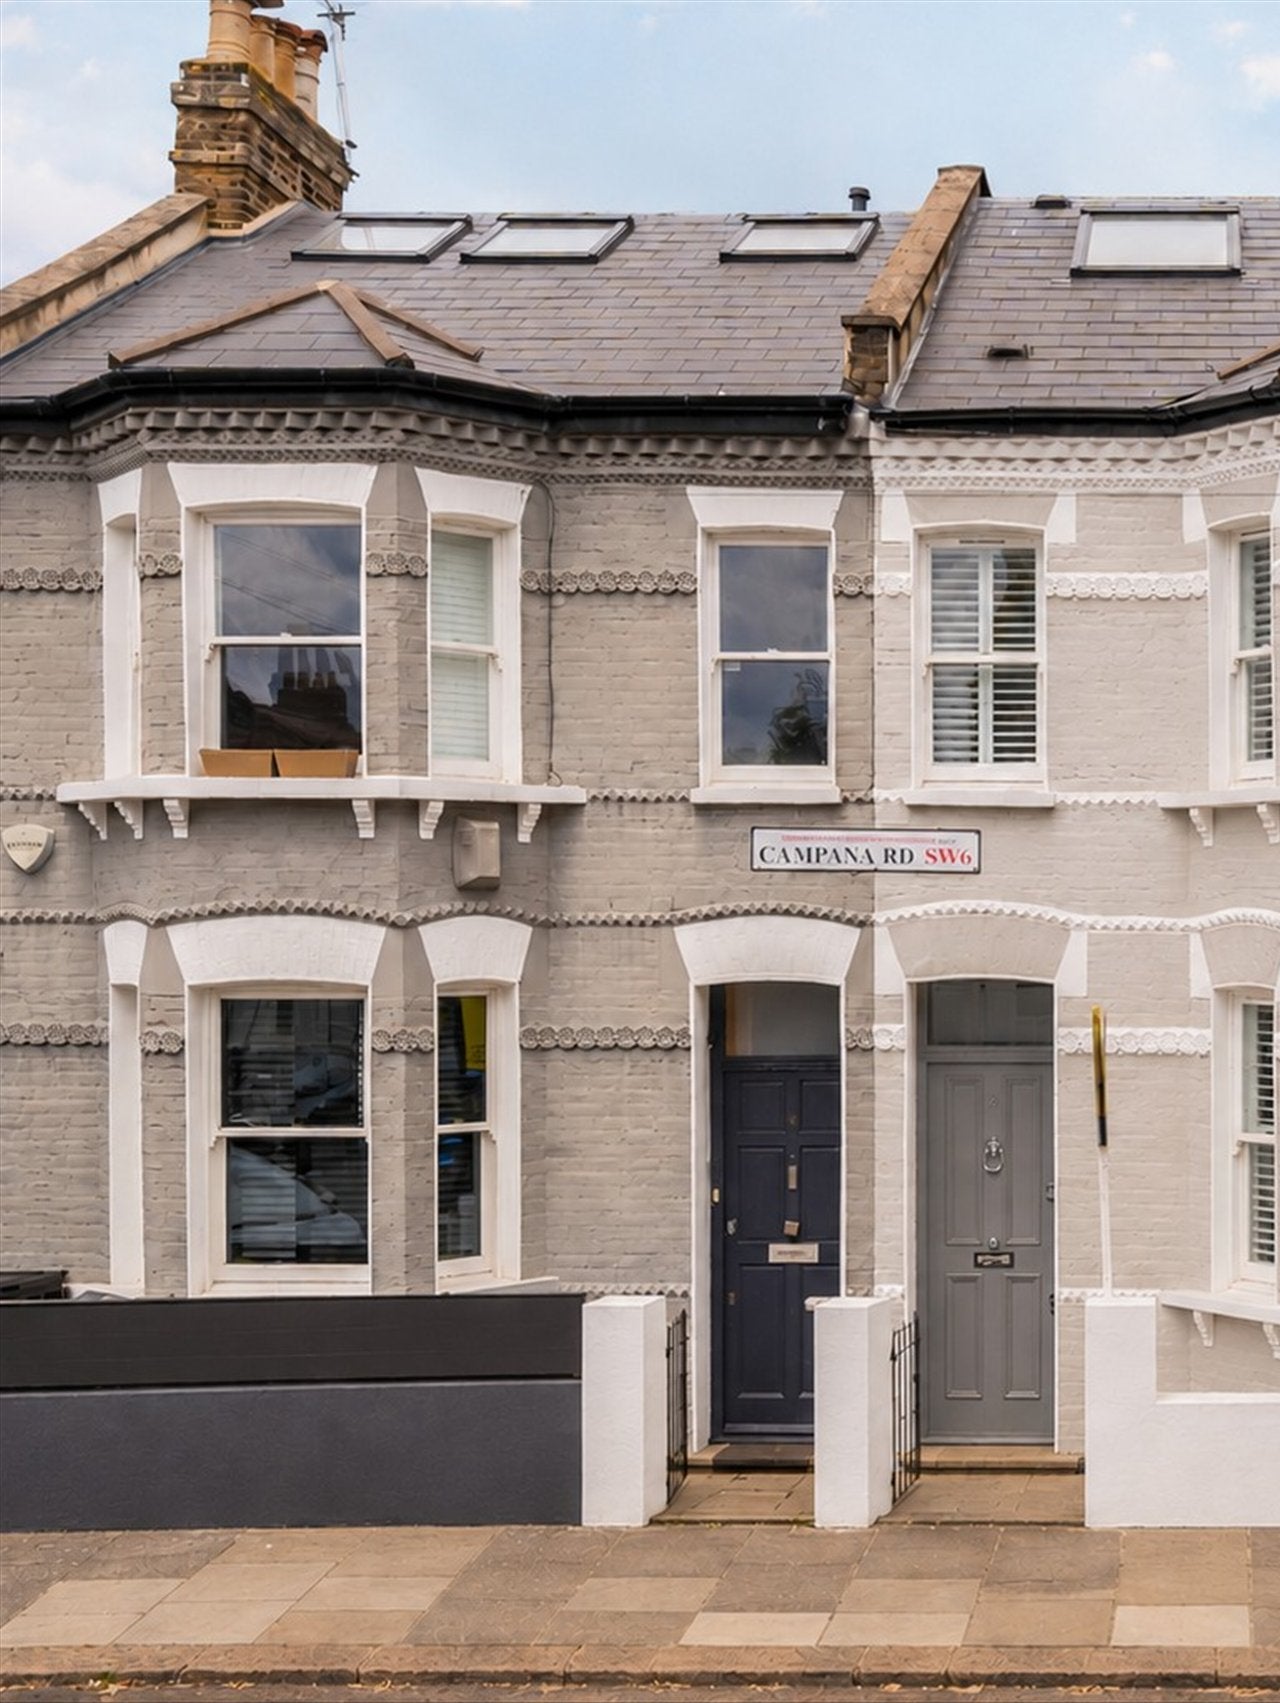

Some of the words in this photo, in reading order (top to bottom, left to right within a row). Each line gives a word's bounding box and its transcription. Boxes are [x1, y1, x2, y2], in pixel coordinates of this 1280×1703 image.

[758, 845, 876, 865] CAMPANA
[883, 847, 915, 865] RD
[924, 847, 973, 866] SW6
